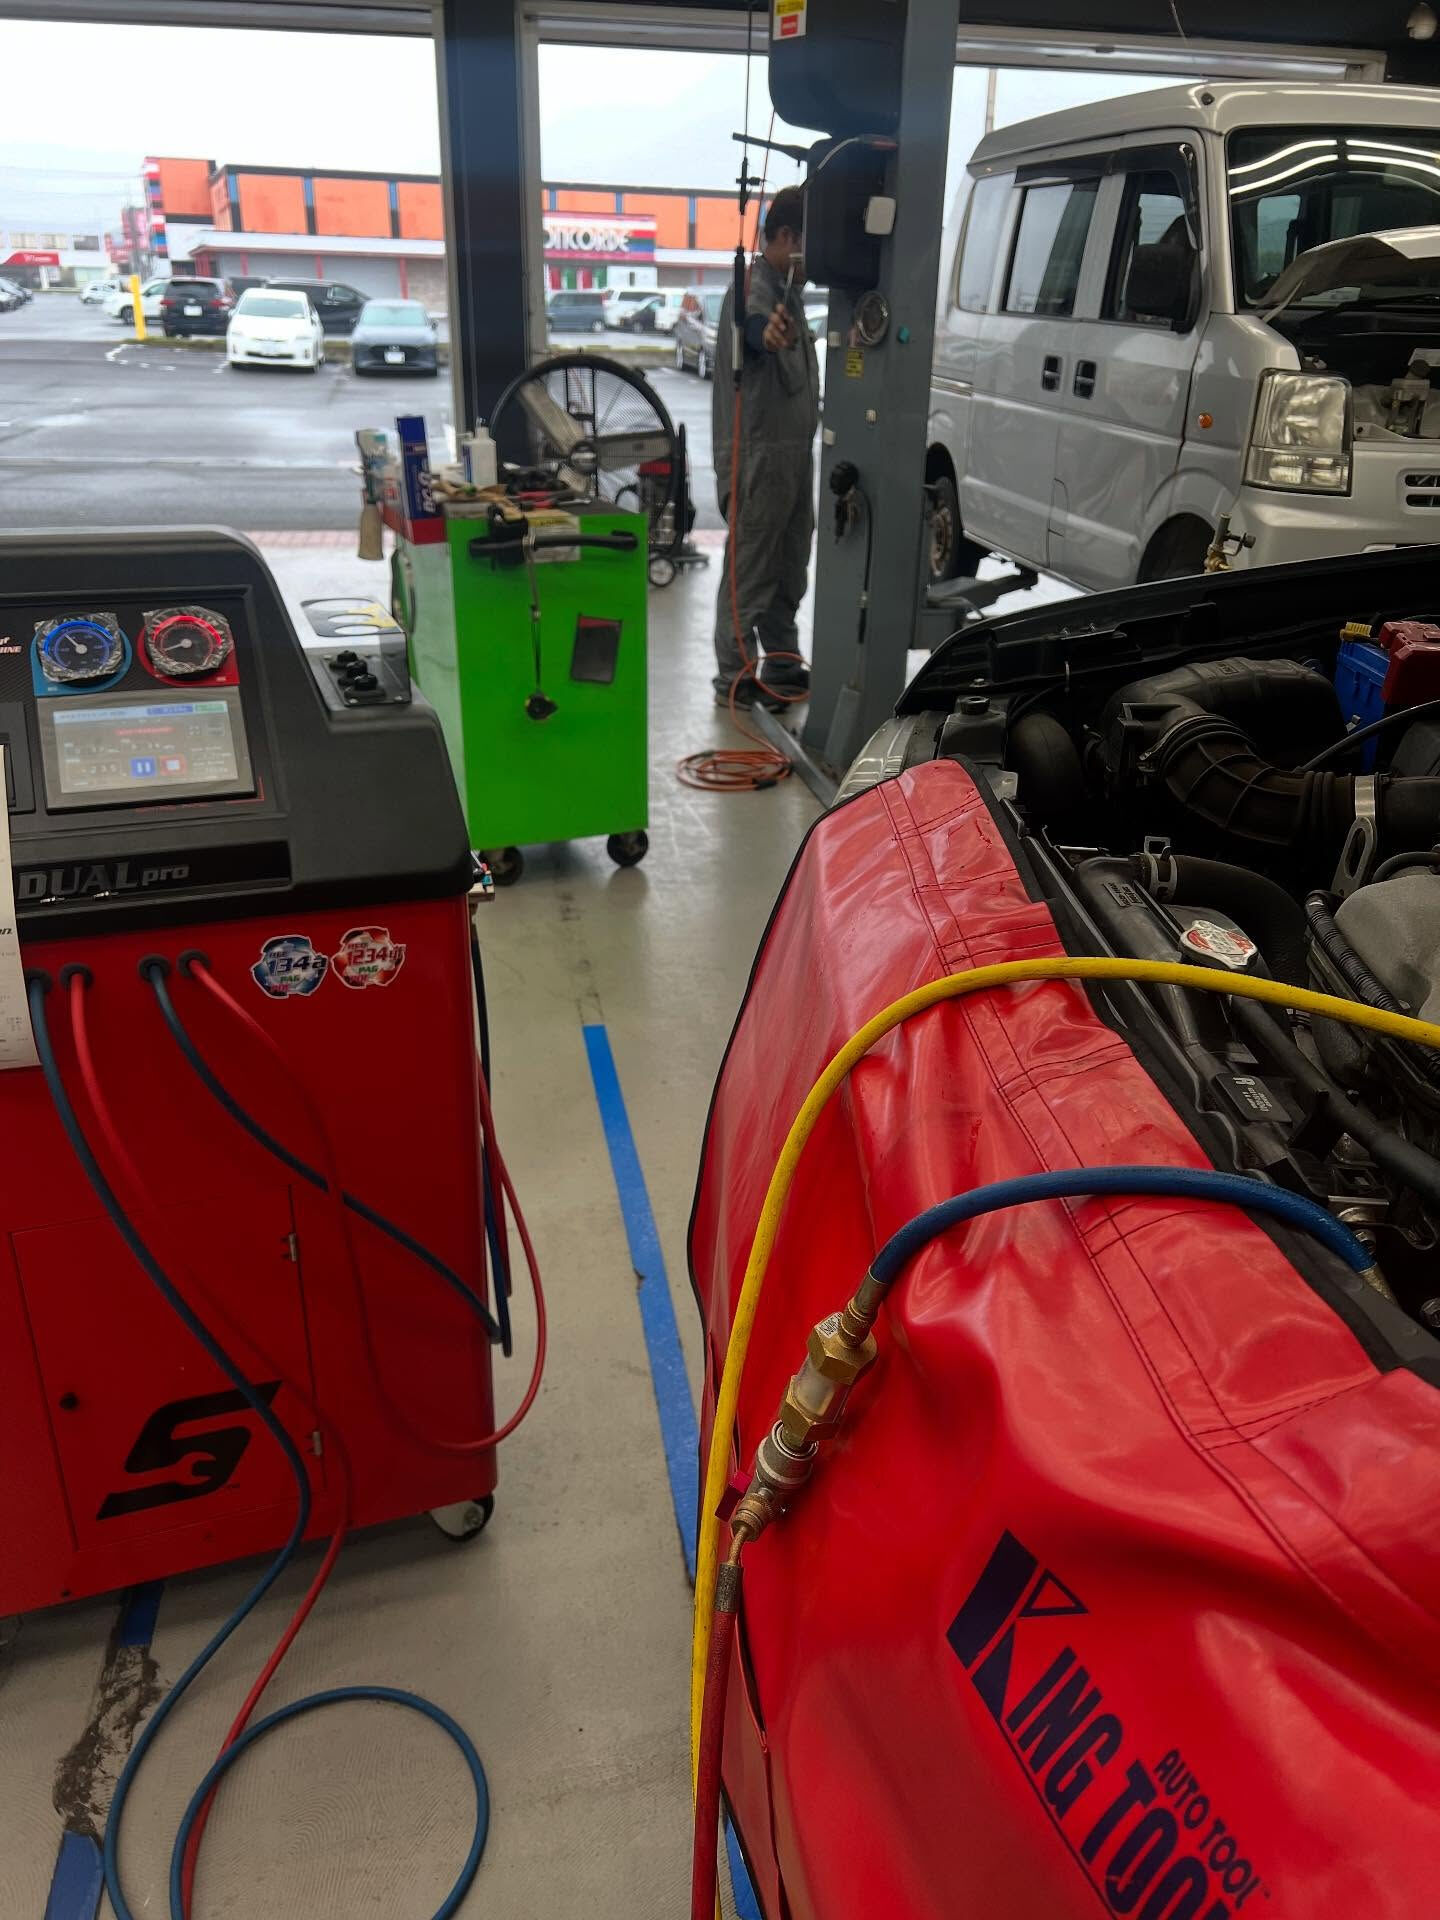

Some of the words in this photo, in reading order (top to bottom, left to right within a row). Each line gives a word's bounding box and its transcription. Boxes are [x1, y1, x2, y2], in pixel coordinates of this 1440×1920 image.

[17, 862, 139, 899] DUAL
[142, 864, 190, 886] pro
[946, 1528, 1123, 1821] KING
[1153, 1748, 1211, 1830] AUTO
[1197, 1817, 1263, 1911] TOOL
